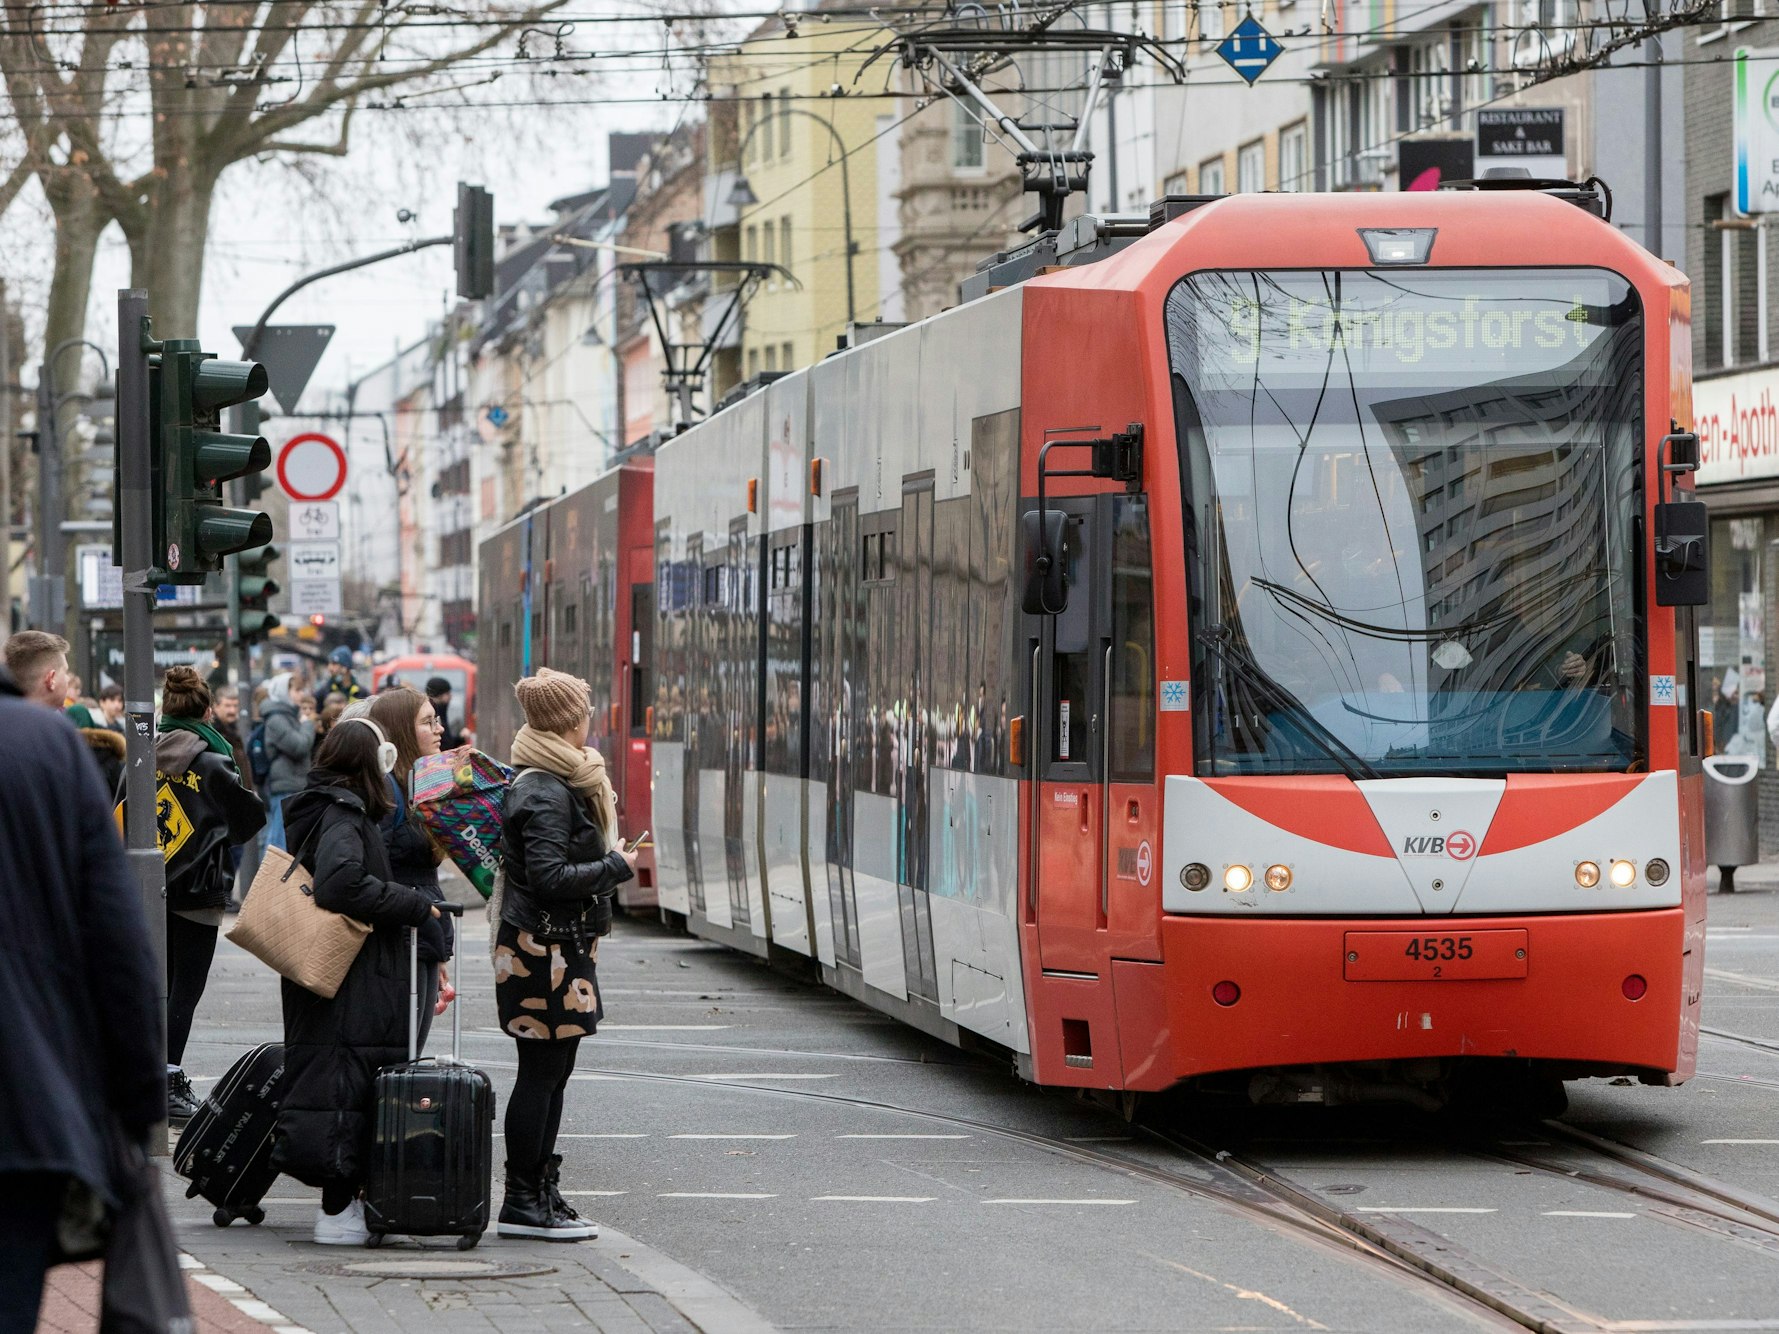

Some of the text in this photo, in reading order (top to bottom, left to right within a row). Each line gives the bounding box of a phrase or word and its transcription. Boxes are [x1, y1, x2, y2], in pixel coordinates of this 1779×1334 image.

[1479, 111, 1560, 125] RESTAURANT
[1514, 125, 1527, 139] &
[1491, 140, 1553, 153] SAKE BAR
[1231, 294, 1589, 364] 9 Königsforst
[1054, 791, 1078, 805] Kein Einstieg
[1403, 837, 1445, 854] KVB
[1405, 937, 1473, 961] 4535
[1433, 966, 1442, 978] 2
[213, 1111, 254, 1164] TRAVELLER
